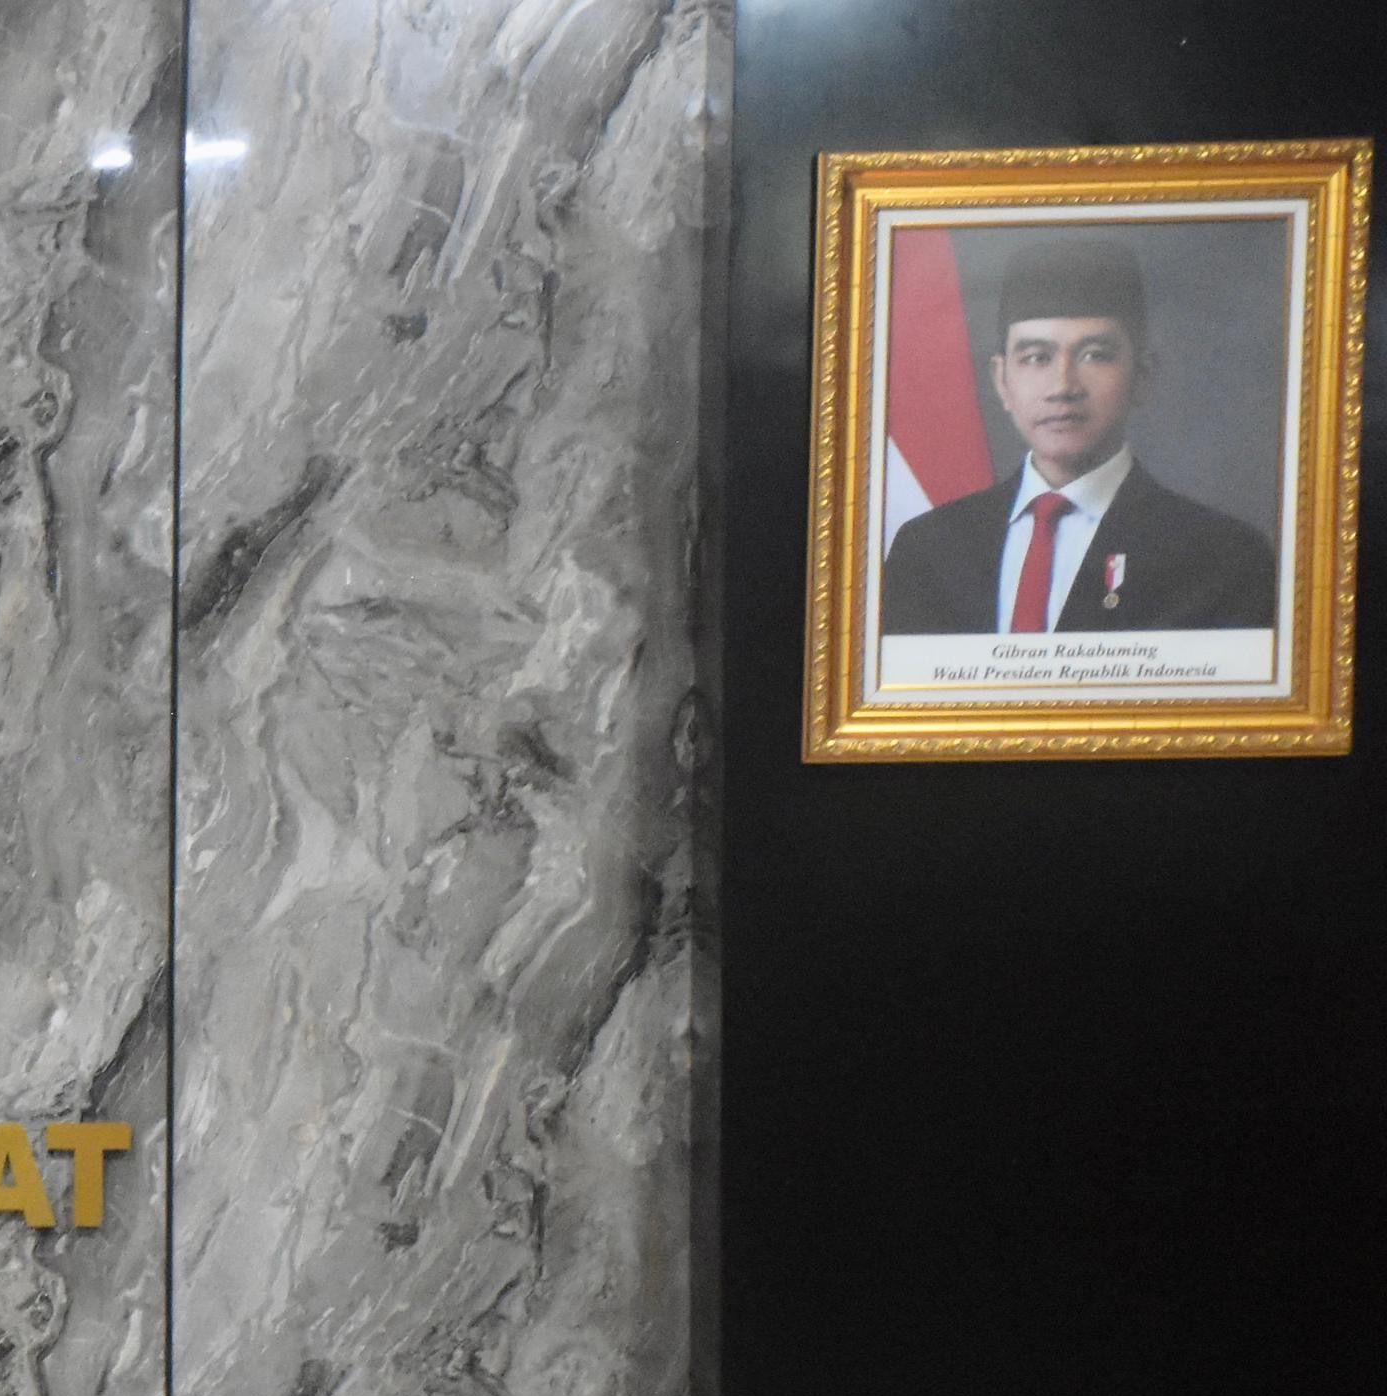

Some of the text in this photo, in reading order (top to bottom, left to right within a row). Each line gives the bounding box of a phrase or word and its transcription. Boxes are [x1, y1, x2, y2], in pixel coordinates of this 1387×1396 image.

[992, 643, 1159, 659] Gibran Rakabuming
[933, 662, 1218, 682] Wakil Presiden Republik Indonesia
